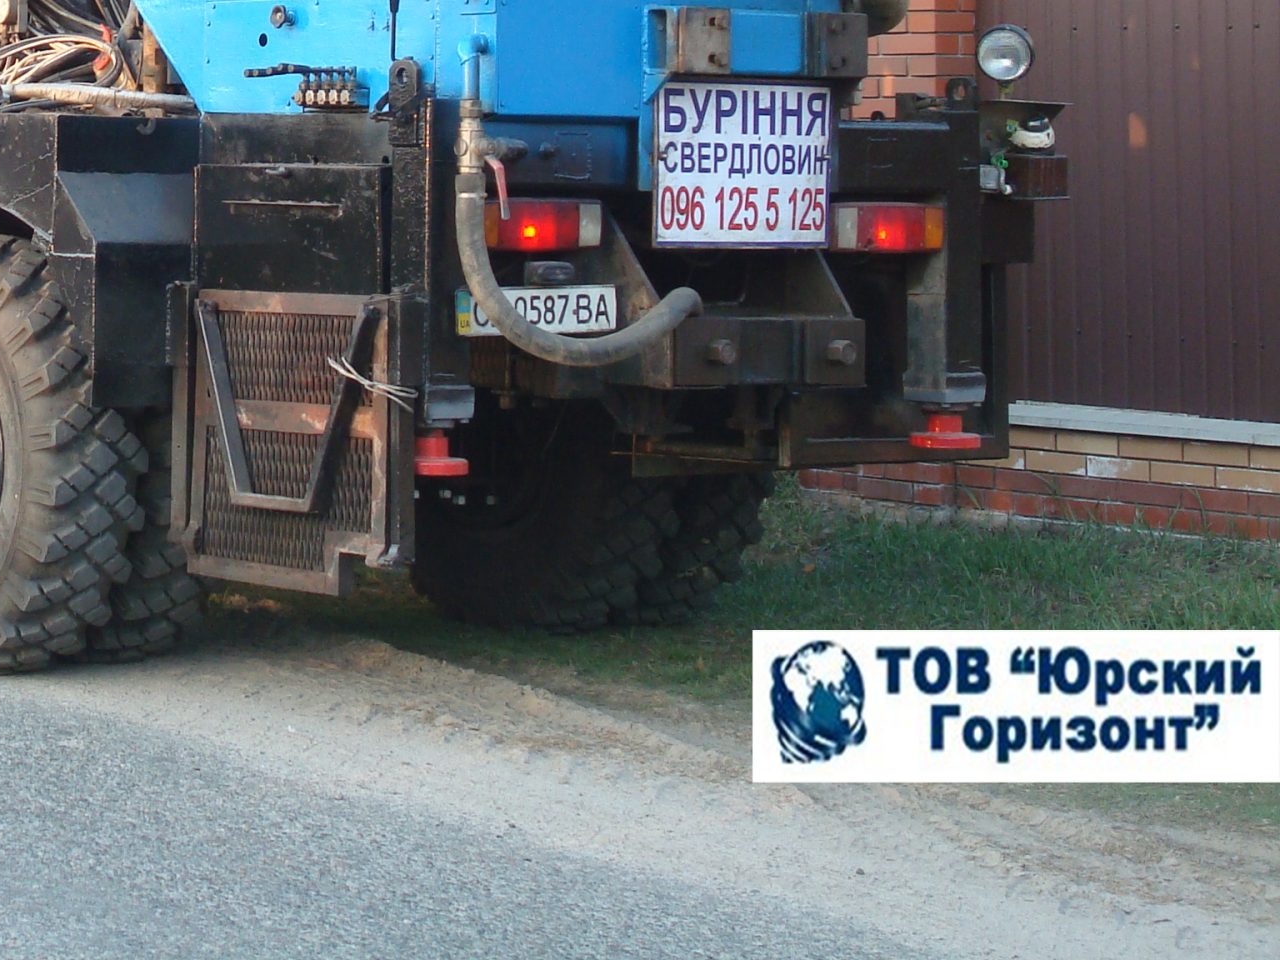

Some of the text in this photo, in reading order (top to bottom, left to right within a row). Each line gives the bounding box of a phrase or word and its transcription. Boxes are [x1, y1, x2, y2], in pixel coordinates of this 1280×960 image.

[663, 87, 827, 136] БУРІННЯ
[663, 141, 825, 179] СВЕРДЛОВИН
[660, 185, 825, 231] 096 125 5 125
[459, 320, 470, 329] UA
[575, 293, 611, 328] BA
